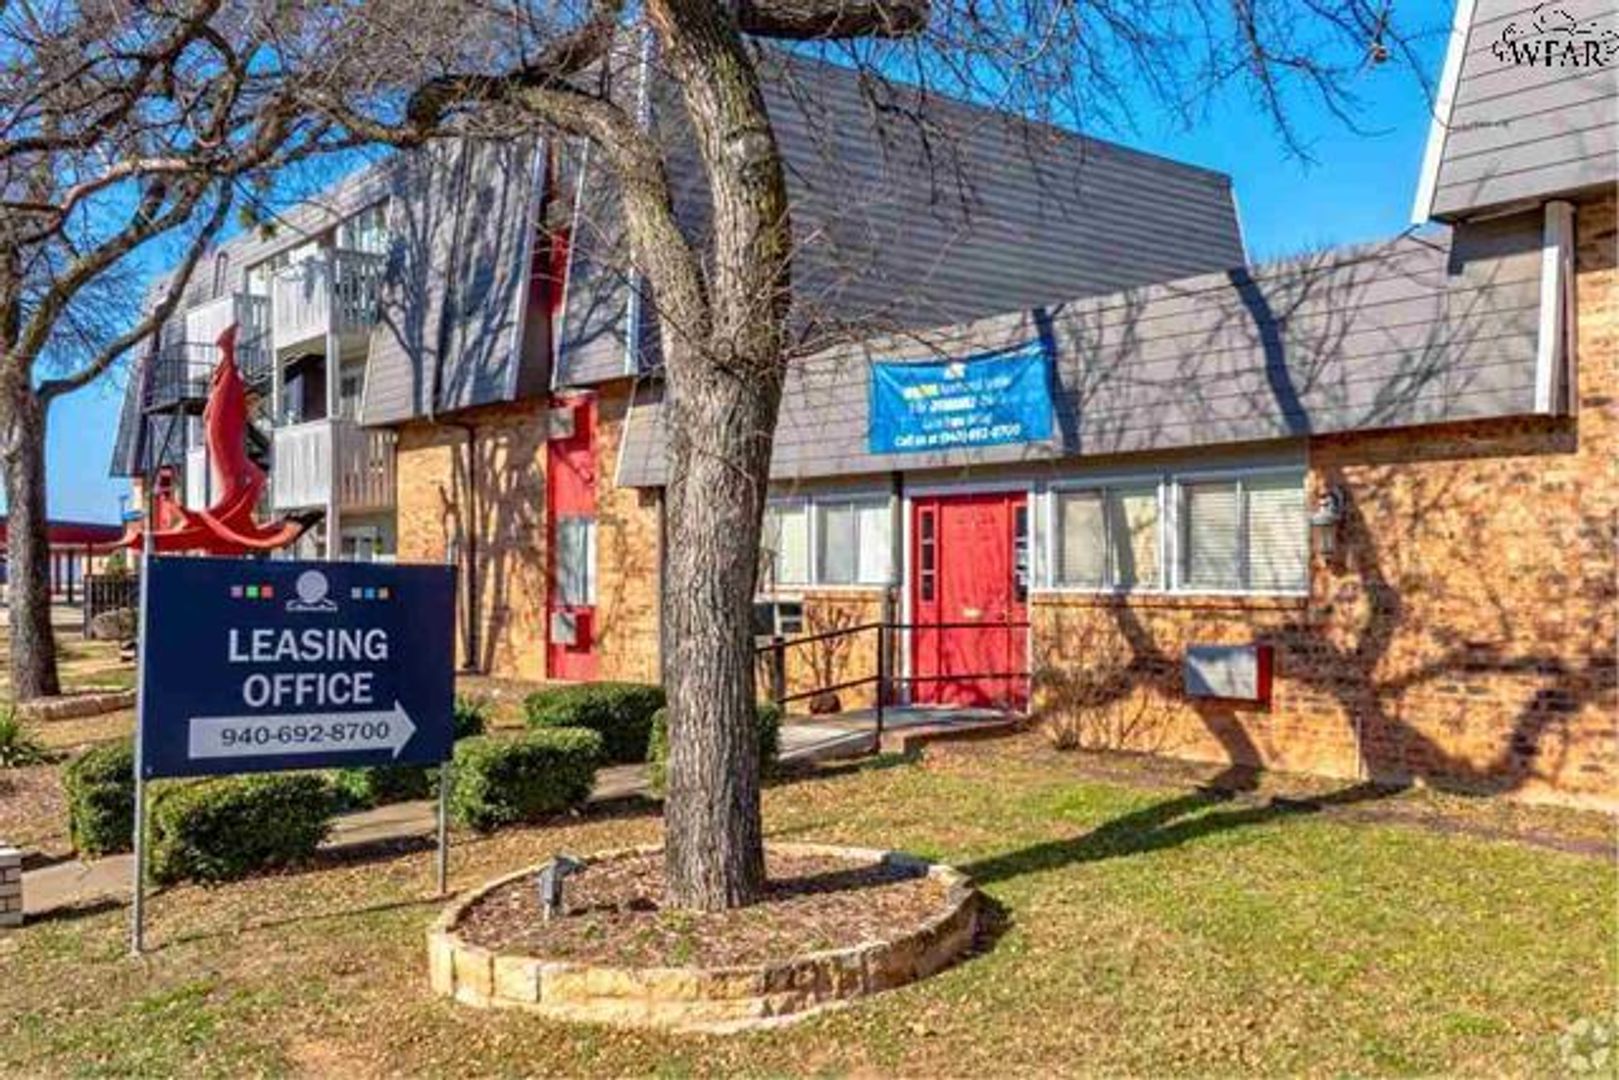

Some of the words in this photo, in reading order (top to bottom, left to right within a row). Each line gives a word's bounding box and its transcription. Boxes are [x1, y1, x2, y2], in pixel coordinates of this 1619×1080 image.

[228, 628, 388, 662] LEASING
[242, 672, 374, 707] OFFICE
[221, 720, 390, 746] 940-692-8700
